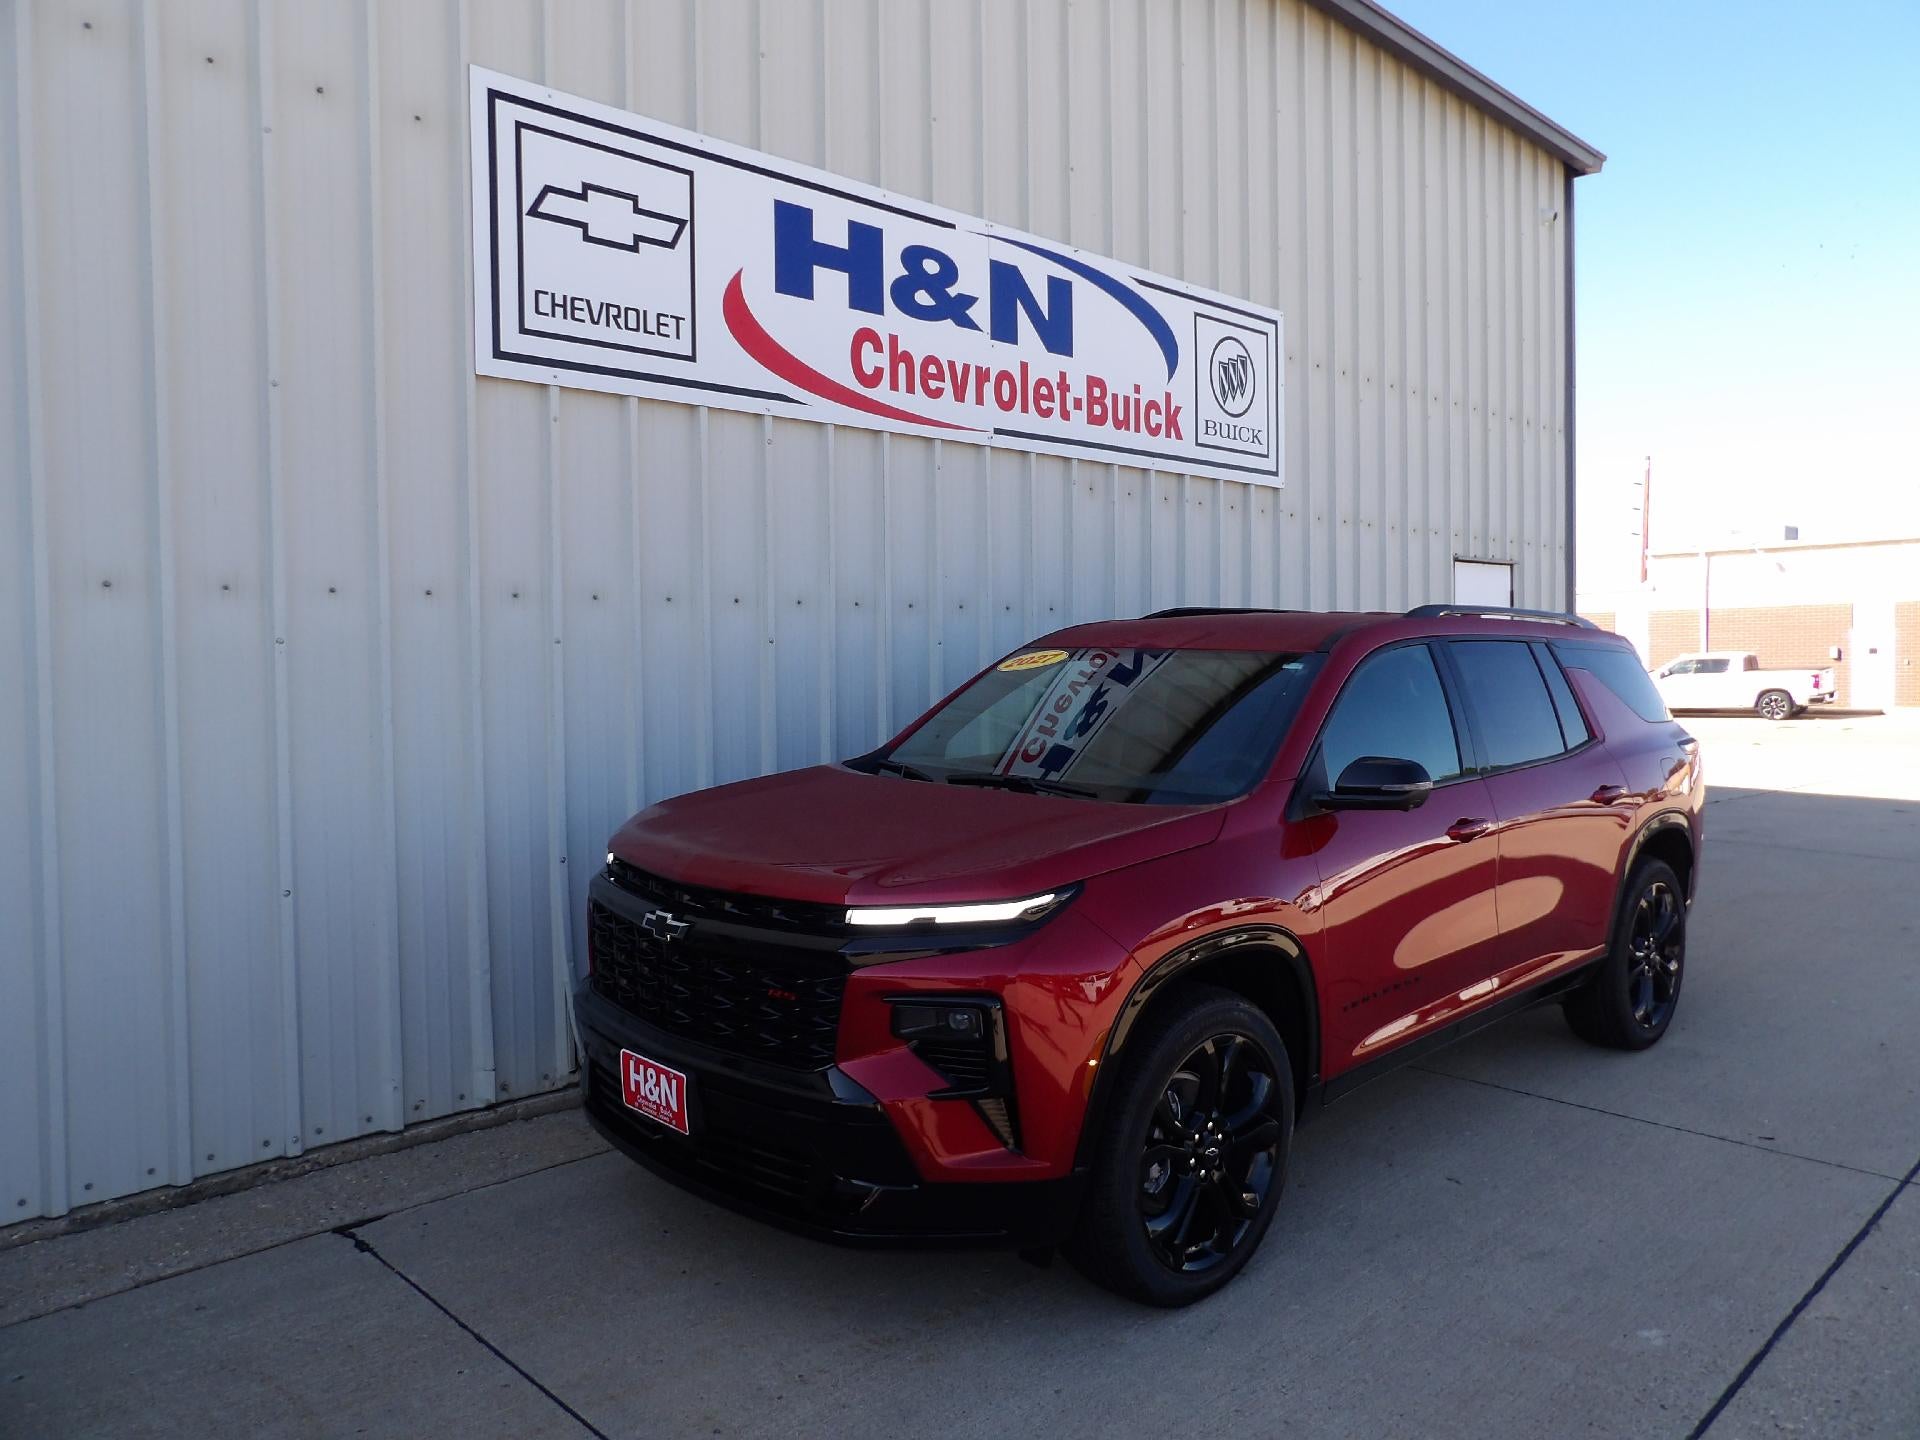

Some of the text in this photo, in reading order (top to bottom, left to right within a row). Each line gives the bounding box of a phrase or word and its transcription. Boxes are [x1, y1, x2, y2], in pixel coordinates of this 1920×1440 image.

[774, 198, 1074, 358] H&N
[534, 289, 686, 340] CHEVROLET
[850, 326, 1183, 441] Chevrolet-Buick
[1203, 419, 1264, 446] BUICK
[629, 1059, 678, 1113] H&N
